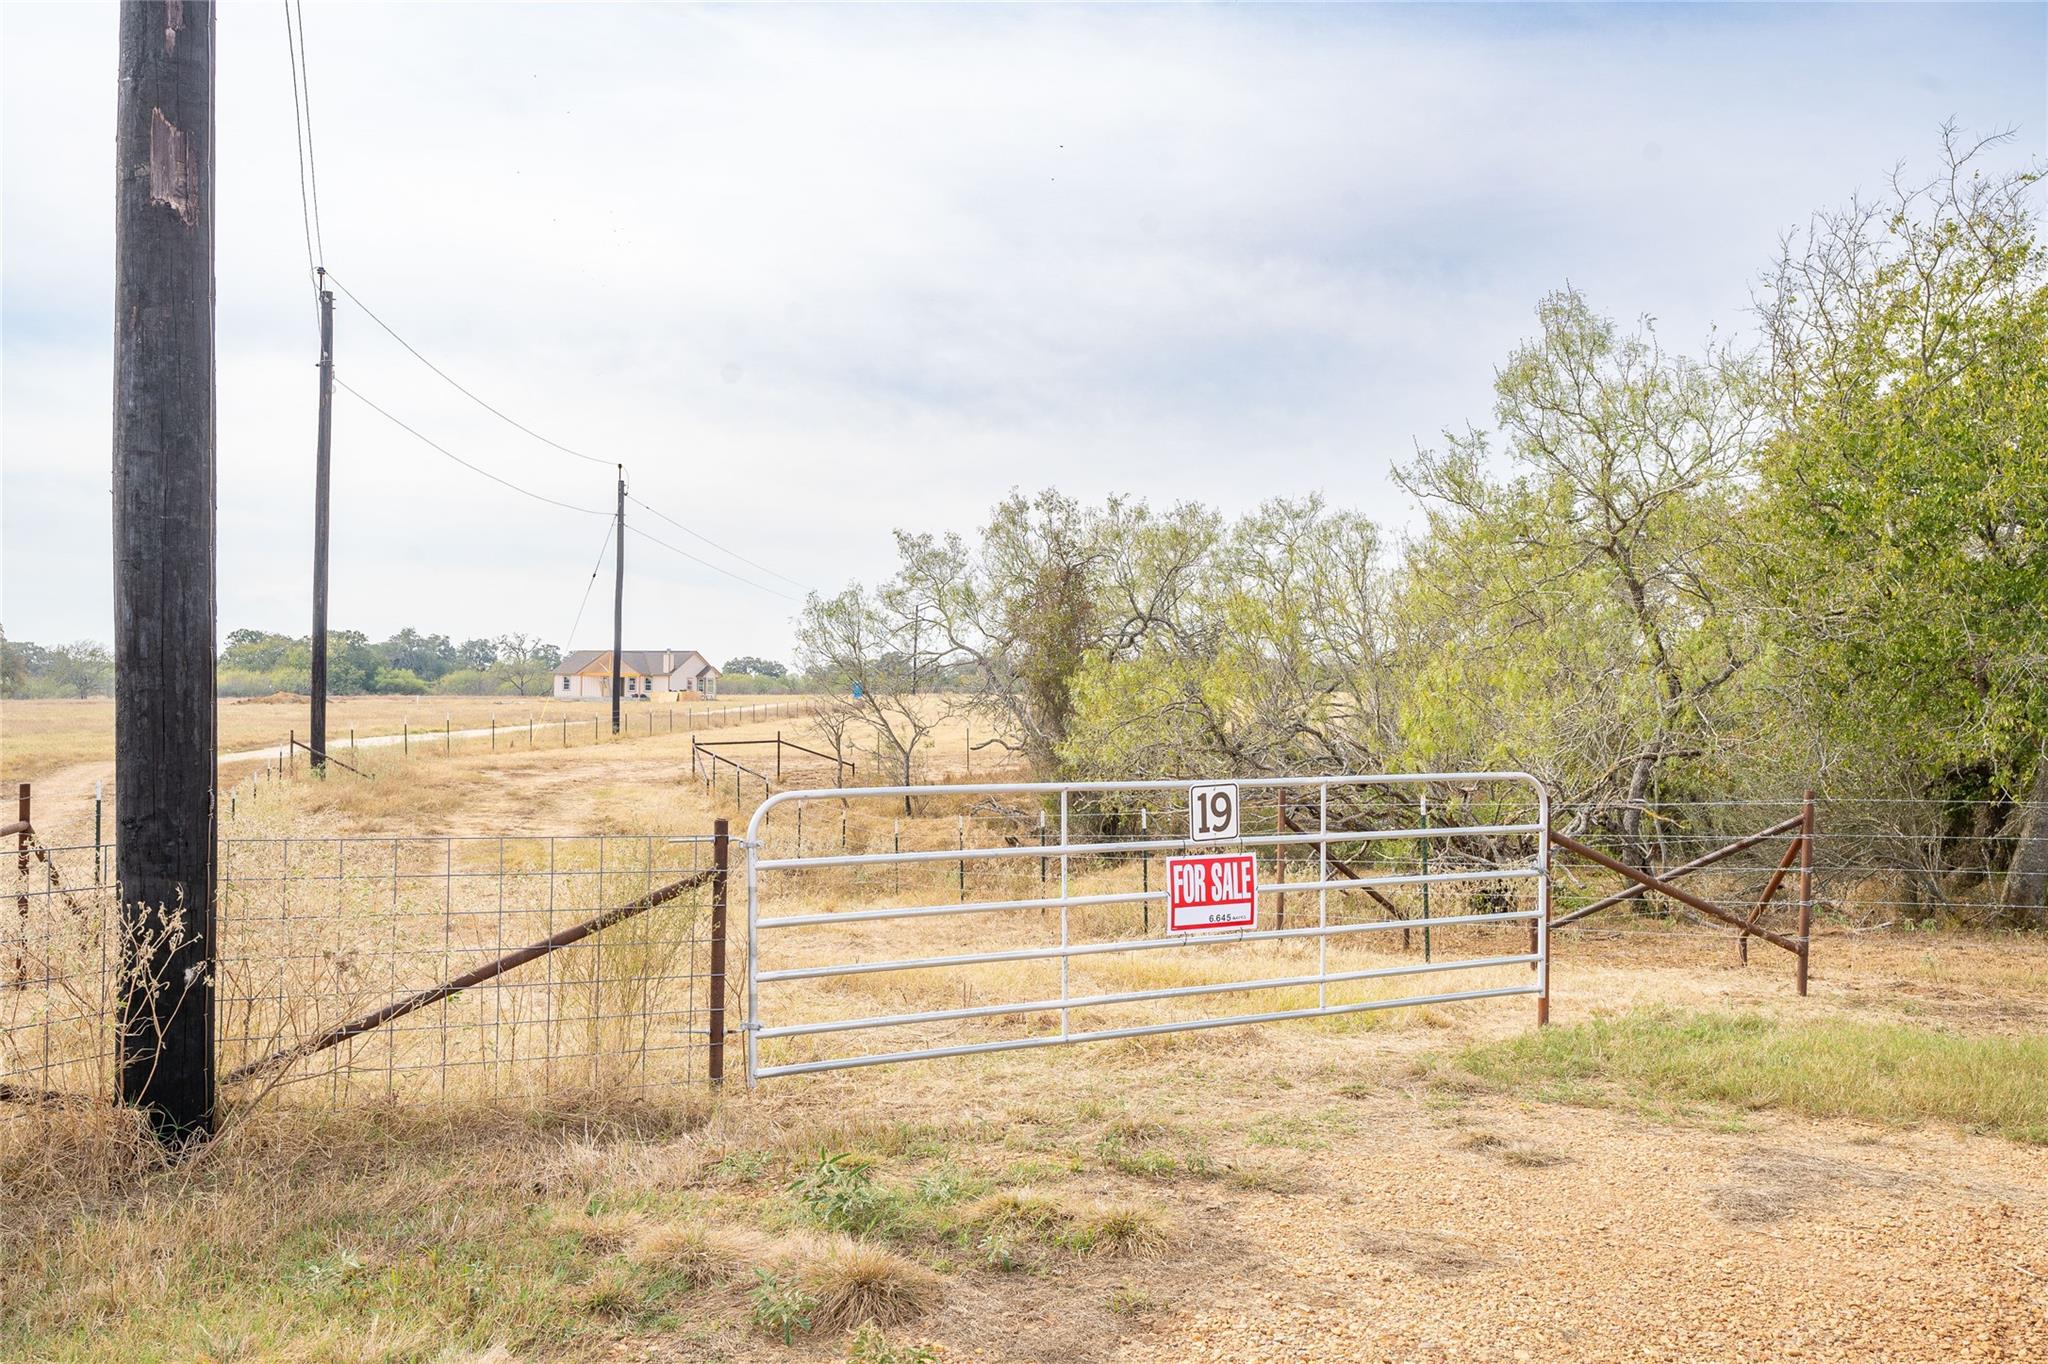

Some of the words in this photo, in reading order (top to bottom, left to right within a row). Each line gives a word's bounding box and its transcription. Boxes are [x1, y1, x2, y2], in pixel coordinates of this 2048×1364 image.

[1197, 791, 1232, 833] 19
[1173, 863, 1206, 904] FOR
[1211, 861, 1252, 902] SALE
[1208, 913, 1232, 922] 6.645
